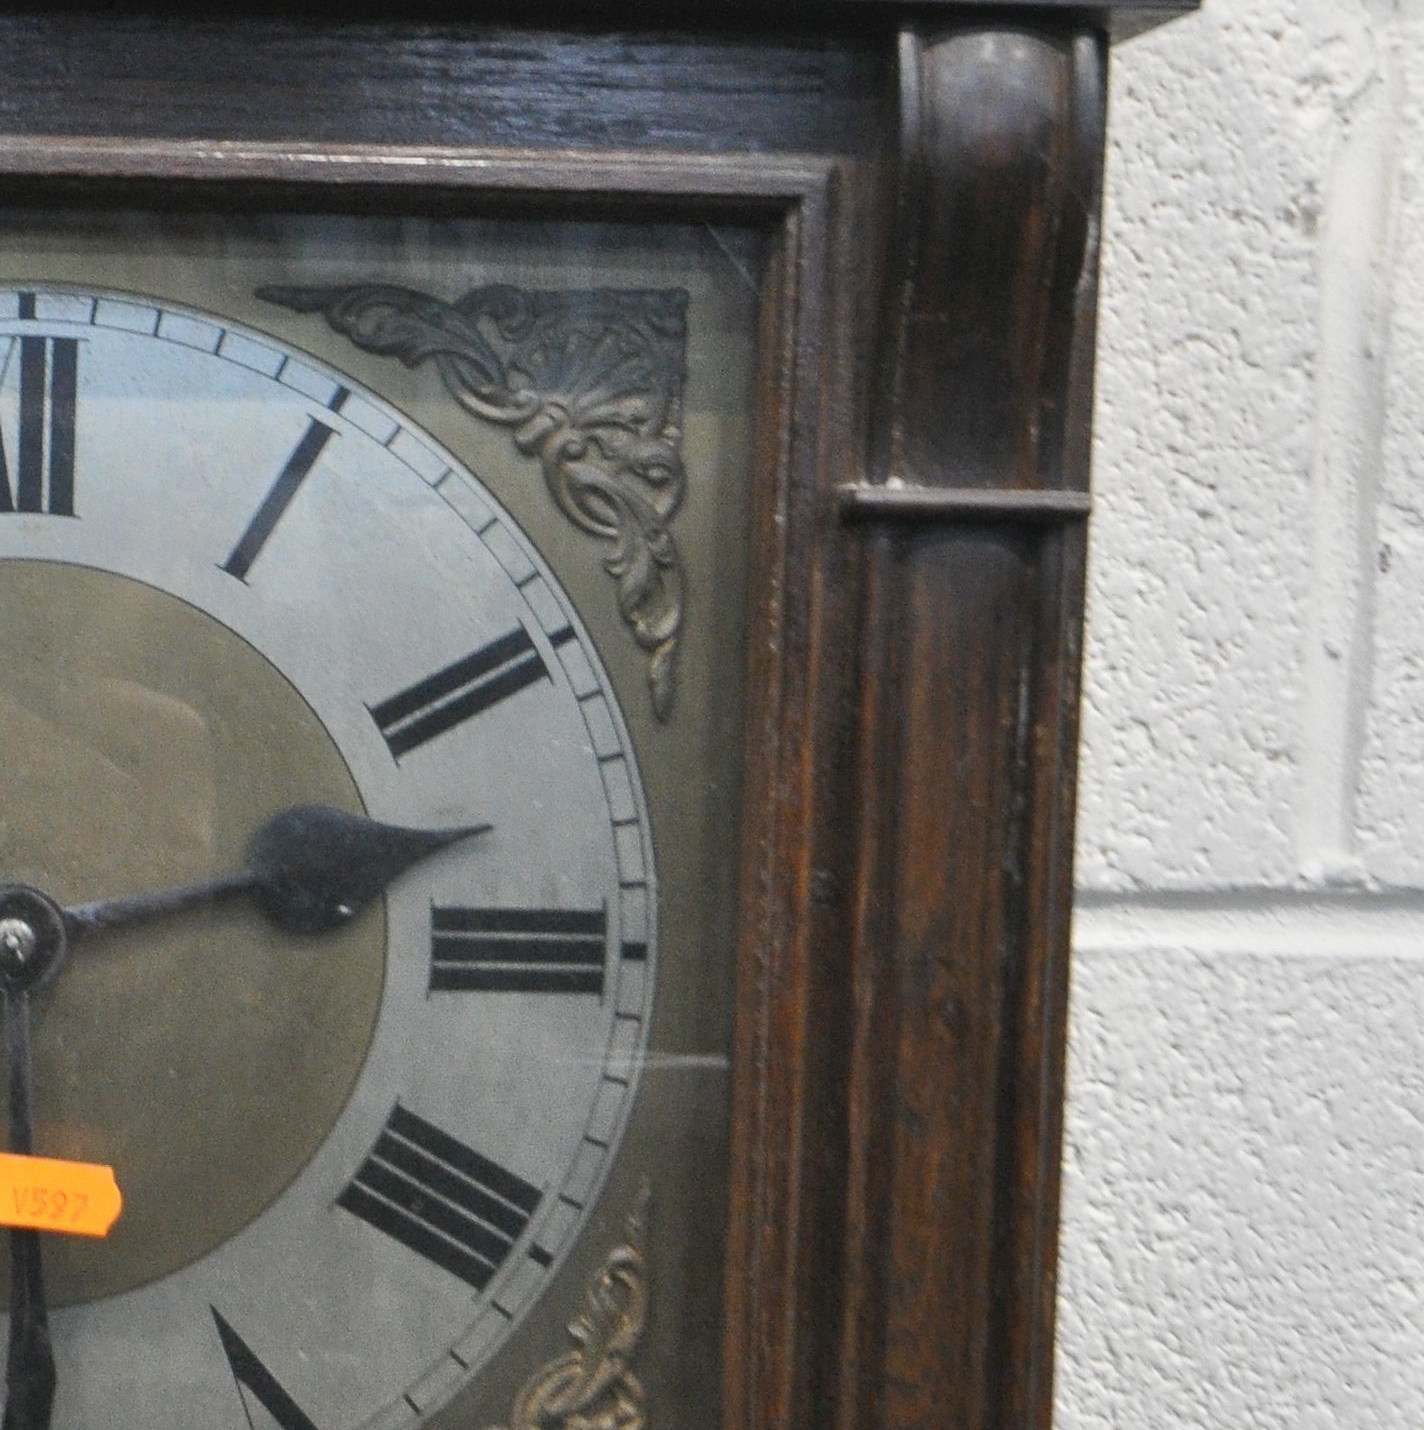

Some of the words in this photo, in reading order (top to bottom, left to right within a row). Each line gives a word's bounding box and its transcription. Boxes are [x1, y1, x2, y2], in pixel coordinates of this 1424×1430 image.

[216, 413, 341, 586] I
[363, 617, 554, 768] II
[427, 897, 607, 1006] III
[12, 1186, 89, 1224] V597
